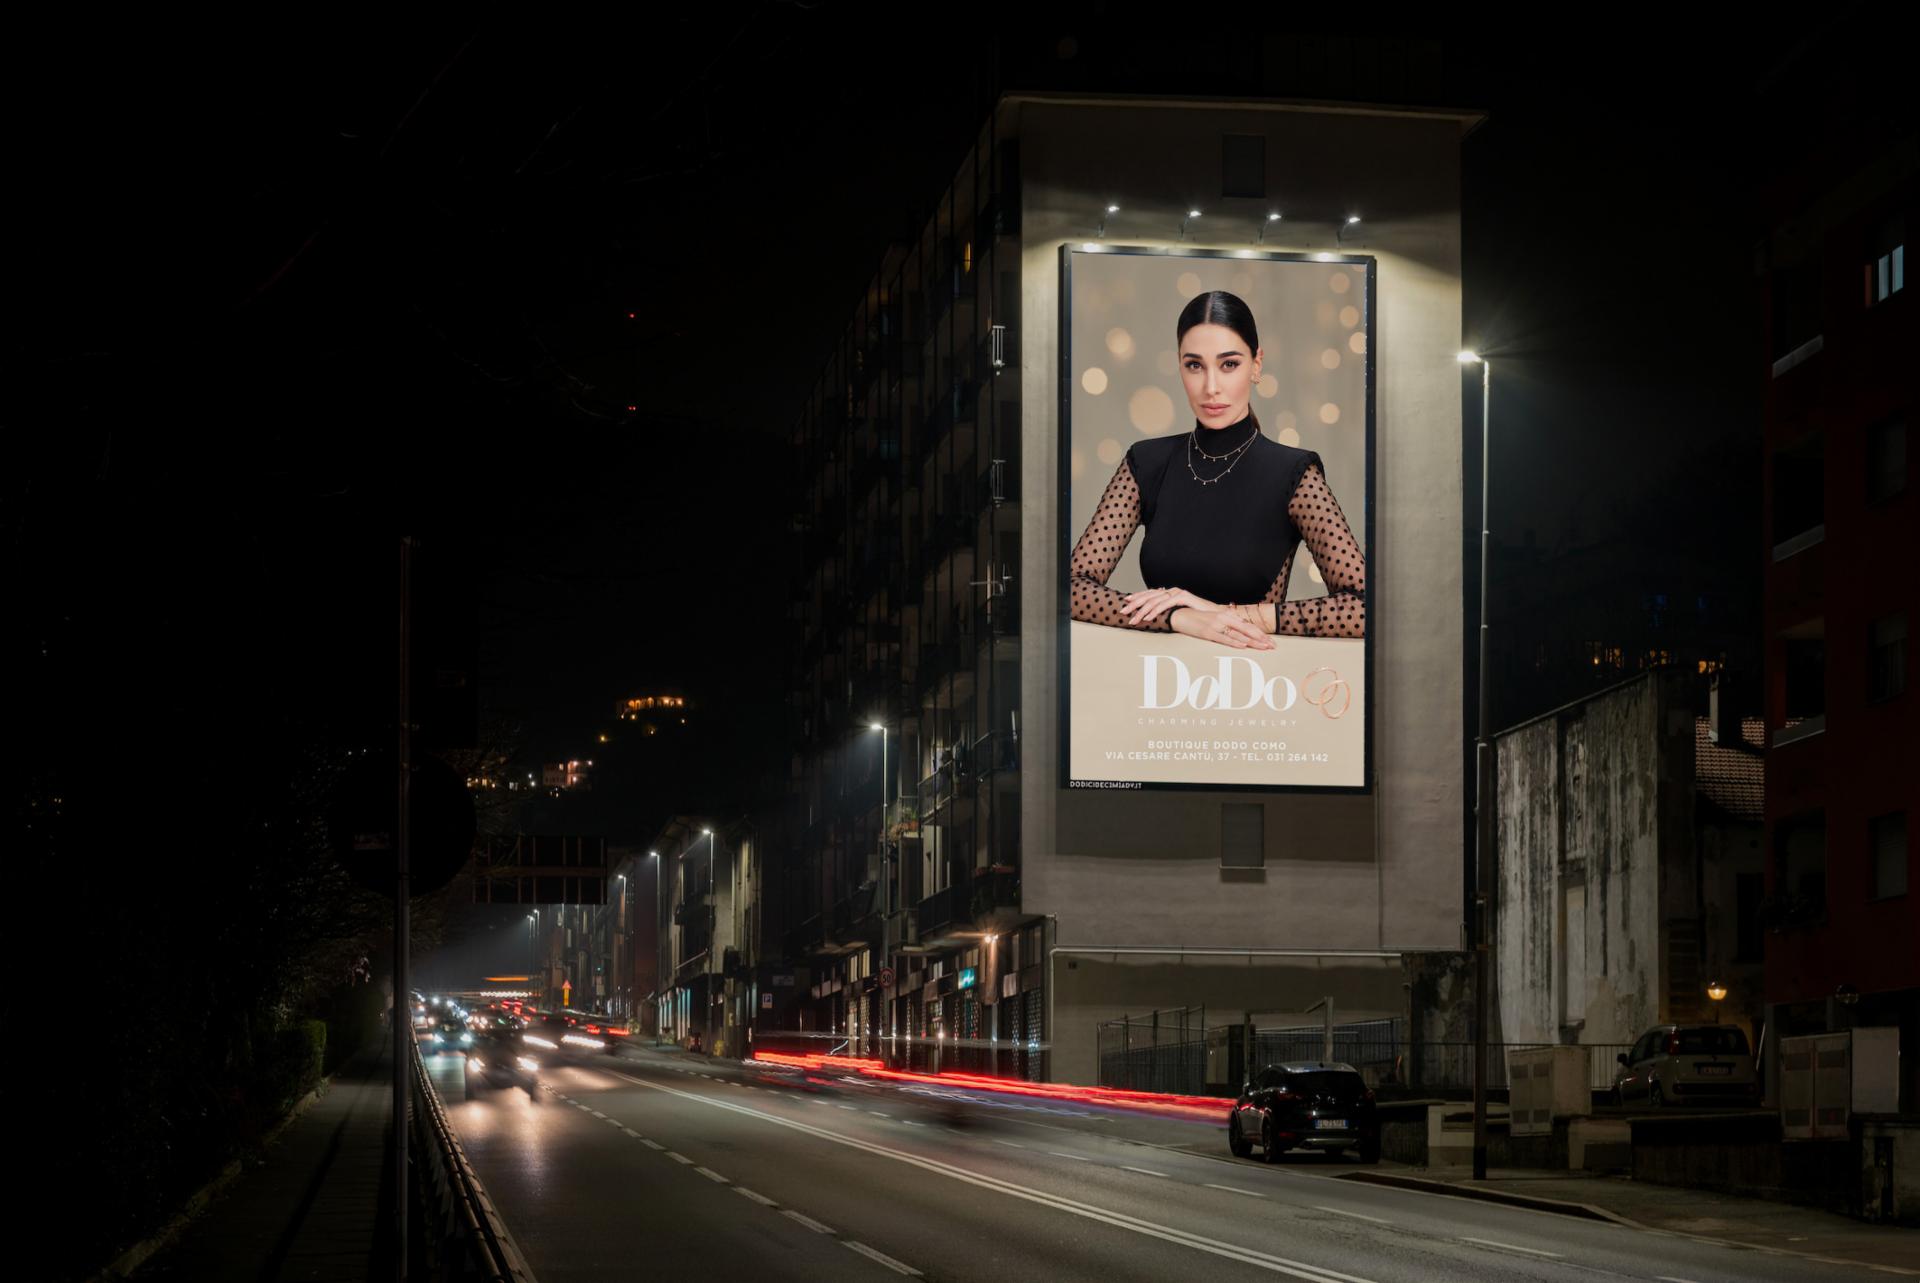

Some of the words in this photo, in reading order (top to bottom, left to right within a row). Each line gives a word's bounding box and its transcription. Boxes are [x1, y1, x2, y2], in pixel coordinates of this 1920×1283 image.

[1138, 655, 1297, 711] DoDo
[1137, 717, 1217, 727] CHARMING
[1228, 718, 1297, 728] JEWELRY
[1148, 740, 1209, 750] BOUTIQUE
[1213, 741, 1248, 750] DODO
[1252, 742, 1287, 751] COMO
[1105, 751, 1124, 760] VIA
[1128, 751, 1170, 761] CESARE
[1217, 752, 1230, 761] 37
[1241, 752, 1263, 761] TEL.
[1266, 752, 1284, 761] 031
[1287, 753, 1308, 762] 264
[1311, 753, 1329, 762] 142
[882, 974, 892, 984] 50
